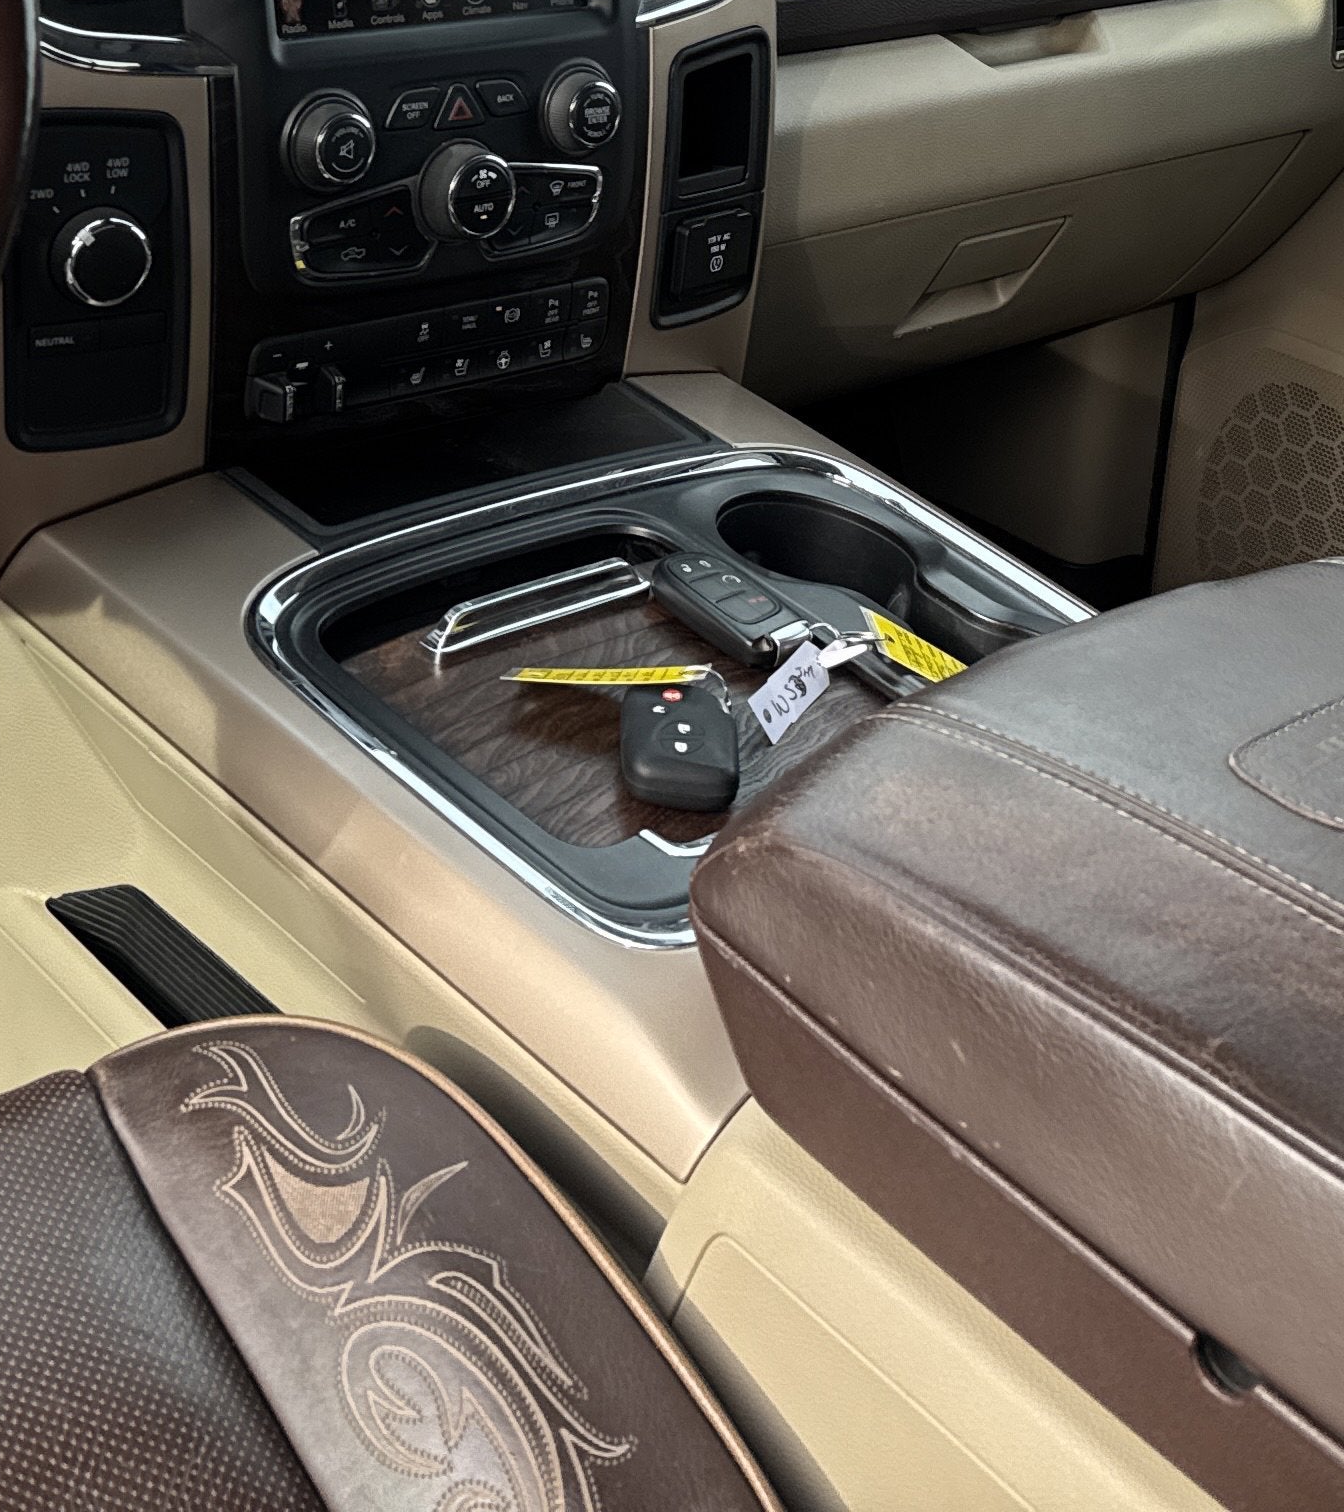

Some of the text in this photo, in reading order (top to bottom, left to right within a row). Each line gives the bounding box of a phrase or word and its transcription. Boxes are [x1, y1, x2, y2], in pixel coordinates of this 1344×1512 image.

[281, 22, 308, 34] Radio
[327, 18, 355, 30] Media
[369, 13, 406, 26] Controls
[496, 92, 515, 104] BACK
[401, 100, 429, 112] SCREEN
[405, 110, 421, 121] OFF
[65, 156, 131, 173] 4WD 4WD
[63, 167, 130, 184] LOCK LOW
[476, 178, 491, 190] OFF
[30, 188, 55, 200] 2WD
[473, 201, 495, 214] AUTO
[338, 217, 357, 230] A/C
[34, 336, 75, 347] NEUTRAL
